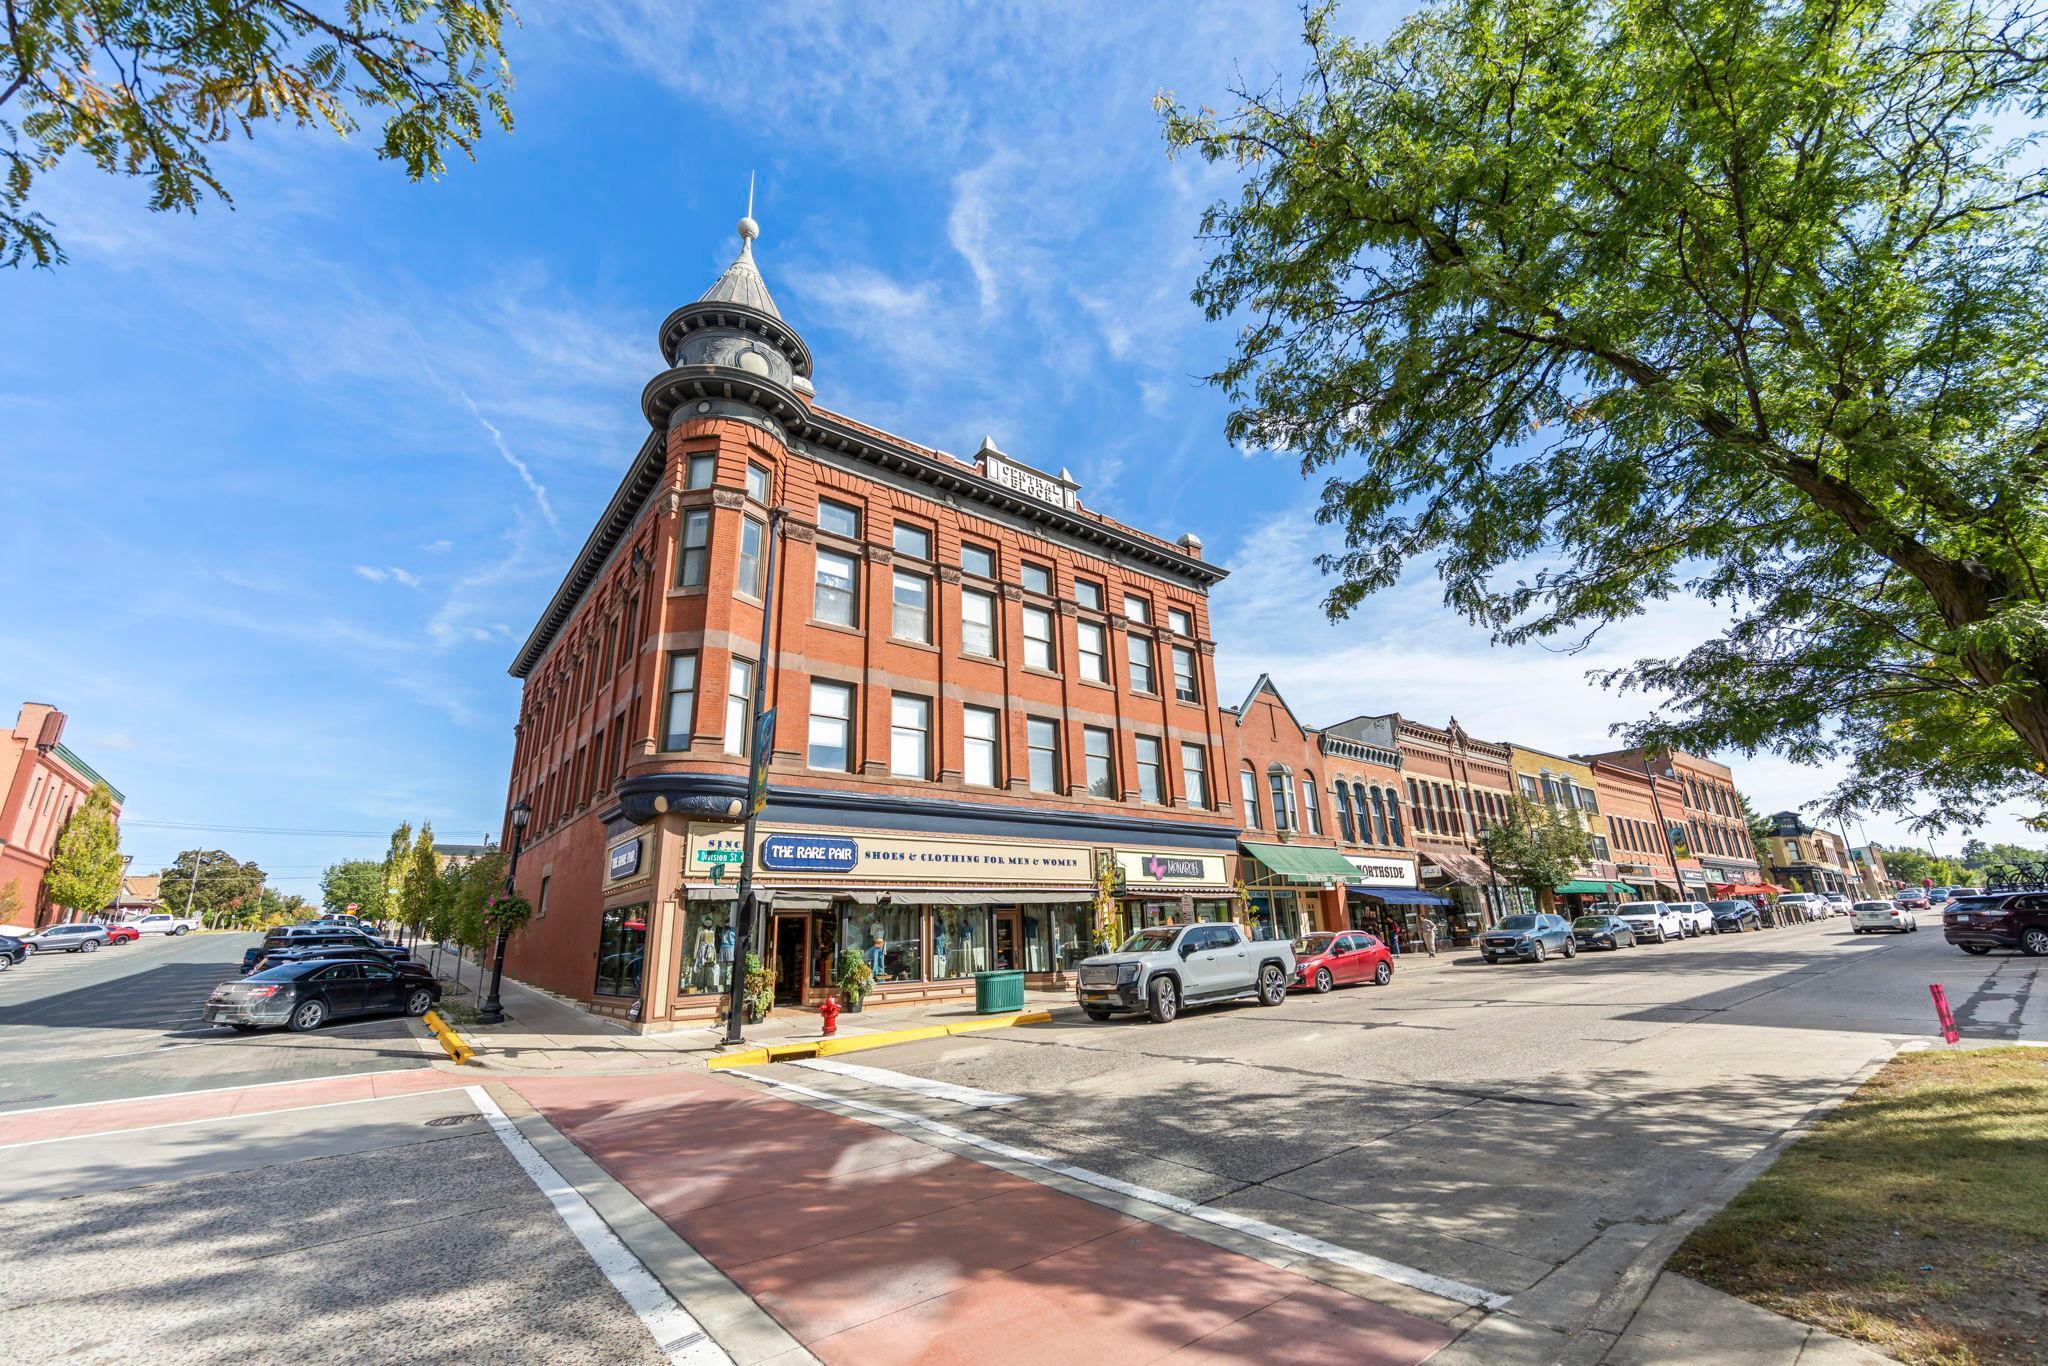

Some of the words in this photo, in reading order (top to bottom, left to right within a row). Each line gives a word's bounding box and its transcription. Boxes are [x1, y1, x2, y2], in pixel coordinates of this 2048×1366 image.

[1002, 465, 1060, 496] CENTRAL
[1010, 478, 1053, 503] BLOCK
[708, 839, 741, 849] SINC
[701, 851, 727, 862] Division
[729, 853, 738, 862] St
[771, 845, 794, 859] THE
[796, 846, 826, 859] RARE
[828, 848, 853, 860] PAIR
[864, 851, 905, 861] SHOES
[908, 853, 917, 861] &
[920, 853, 980, 863] CLOTHING
[983, 856, 1005, 864] FOR
[1008, 857, 1030, 865] MEN
[1032, 858, 1040, 866] &
[1042, 858, 1078, 867] WOMEN
[1167, 860, 1200, 876] MONARCH
[1356, 864, 1405, 879] NORTHSIDE
